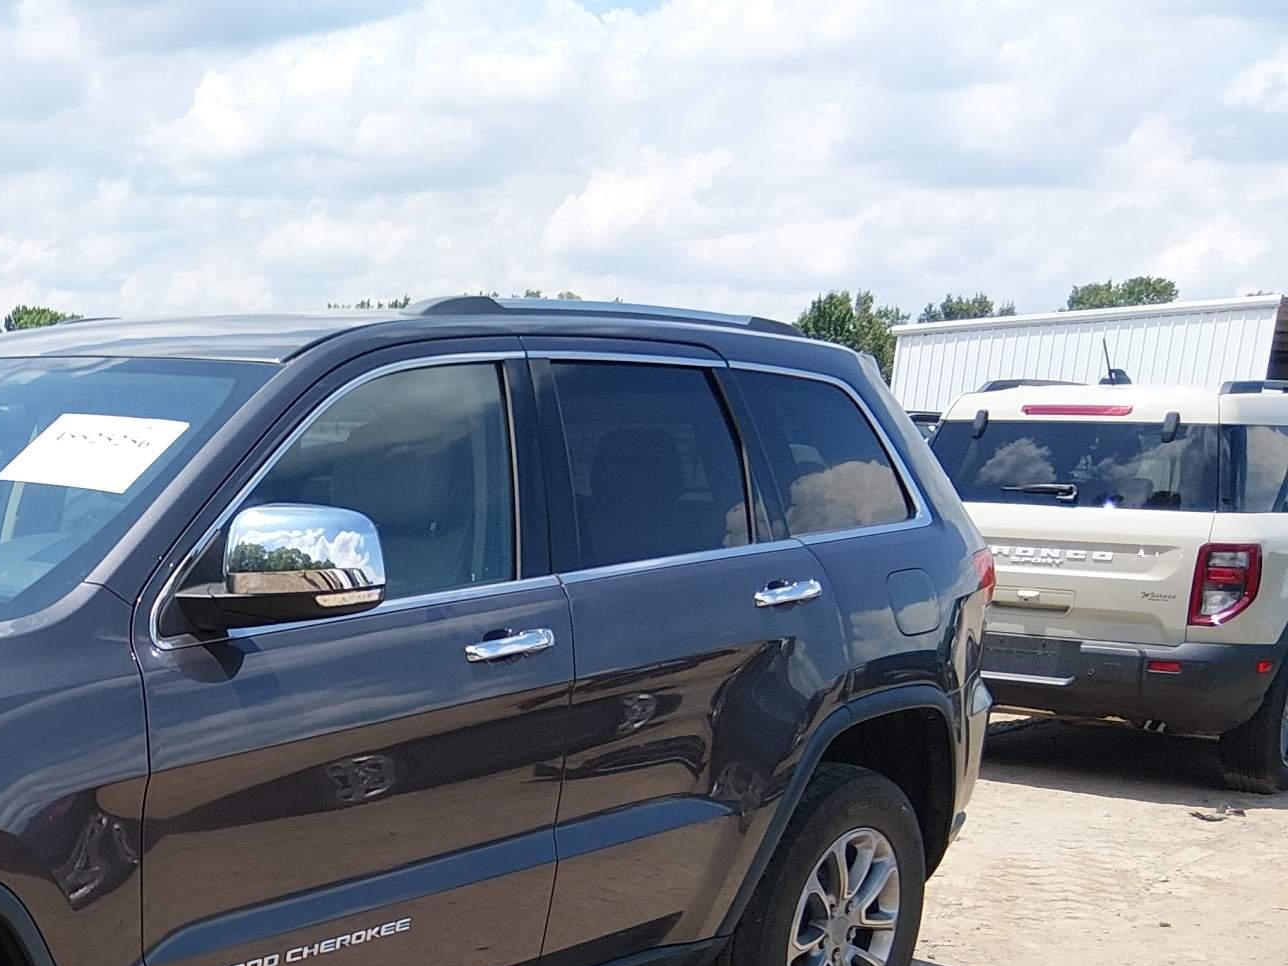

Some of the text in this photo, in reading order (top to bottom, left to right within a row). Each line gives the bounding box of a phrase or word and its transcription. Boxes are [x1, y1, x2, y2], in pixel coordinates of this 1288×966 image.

[988, 545, 1113, 564] RONCO
[1009, 555, 1064, 568] SPORT
[285, 918, 412, 964] CHEROKEE
